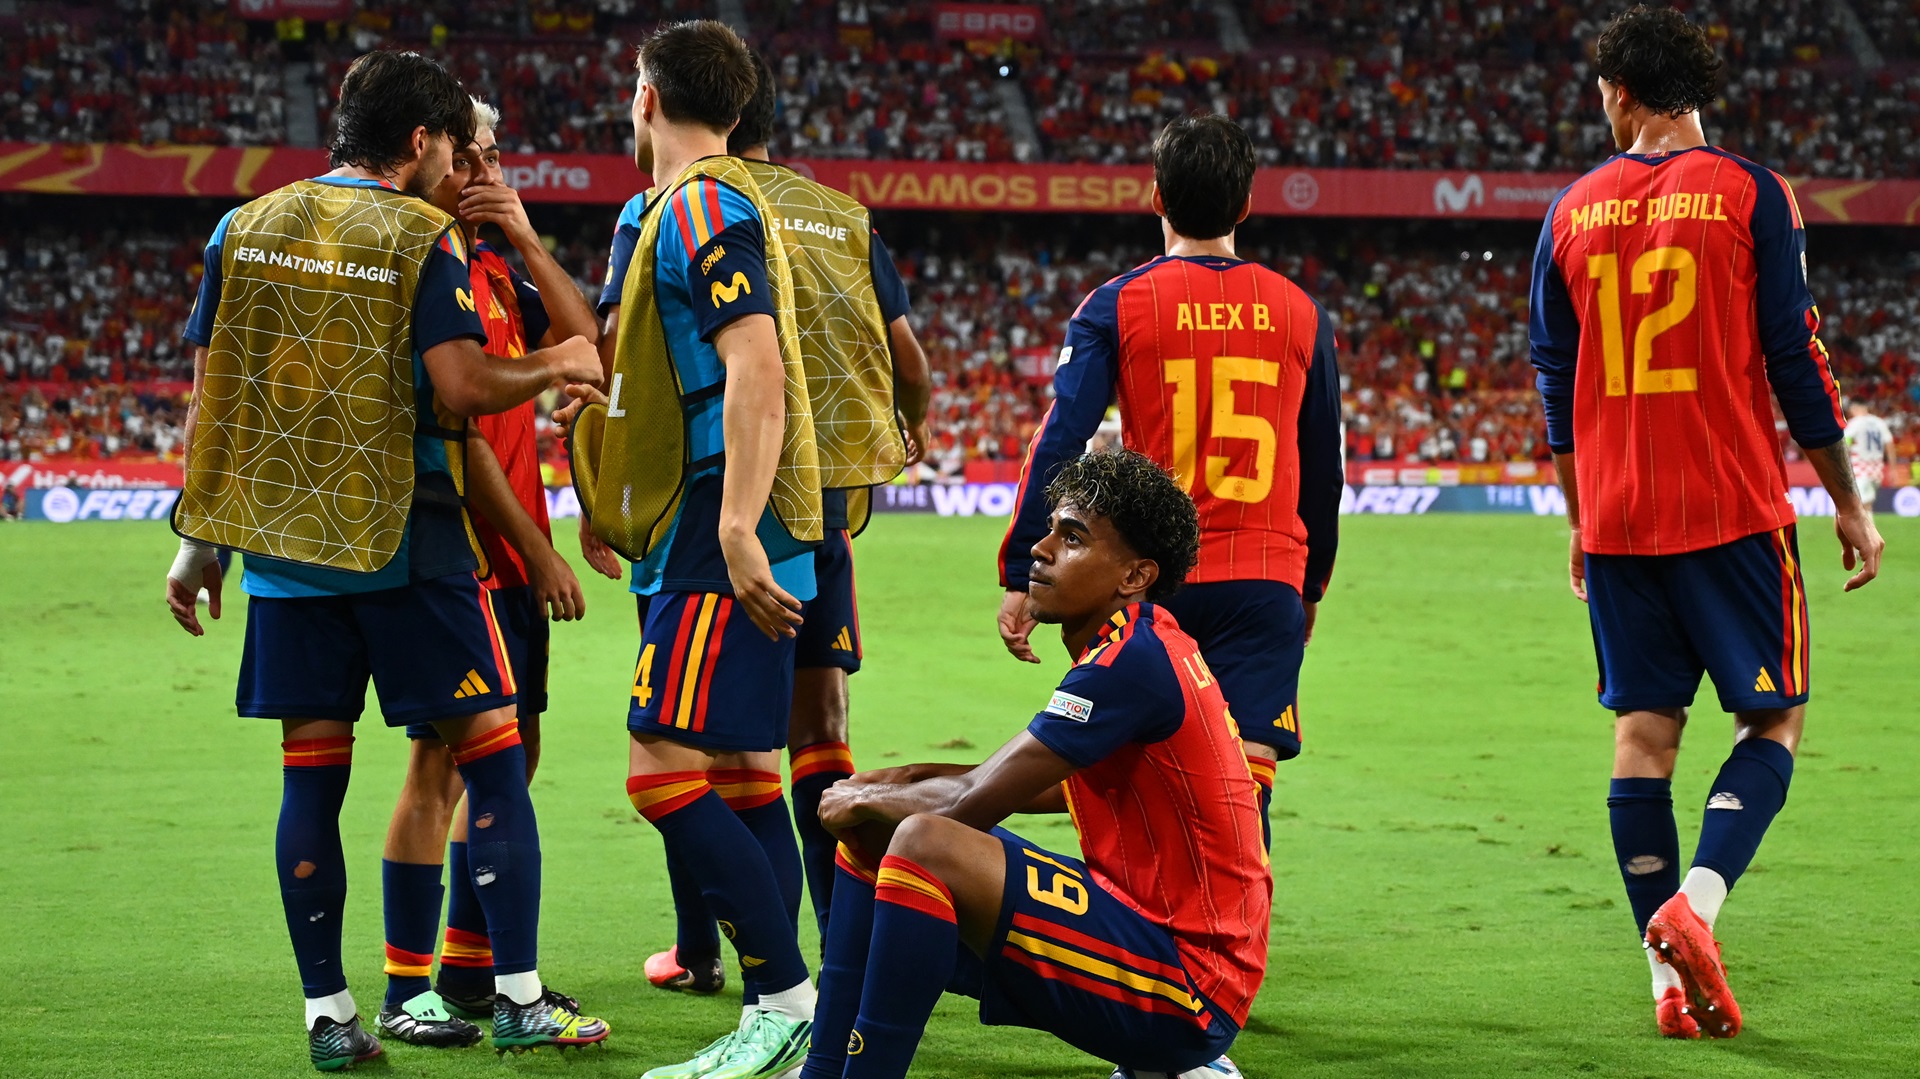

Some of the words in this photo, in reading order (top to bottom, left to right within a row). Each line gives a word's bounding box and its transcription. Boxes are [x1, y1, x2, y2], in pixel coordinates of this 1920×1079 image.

[784, 217, 847, 241] LEAGUE
[1570, 199, 1638, 236] MARC
[1646, 192, 1728, 226] PUBILL
[268, 250, 335, 275] NATIONS
[335, 261, 399, 286] LEAGUE
[701, 244, 727, 276] ESPAÑA
[1176, 303, 1245, 331] ALEX
[1252, 303, 1276, 333] B.
[1587, 246, 1699, 397] 12
[1164, 356, 1280, 504] 15
[886, 485, 928, 508] THE
[1486, 485, 1525, 505] THE
[1022, 847, 1089, 916] 19
